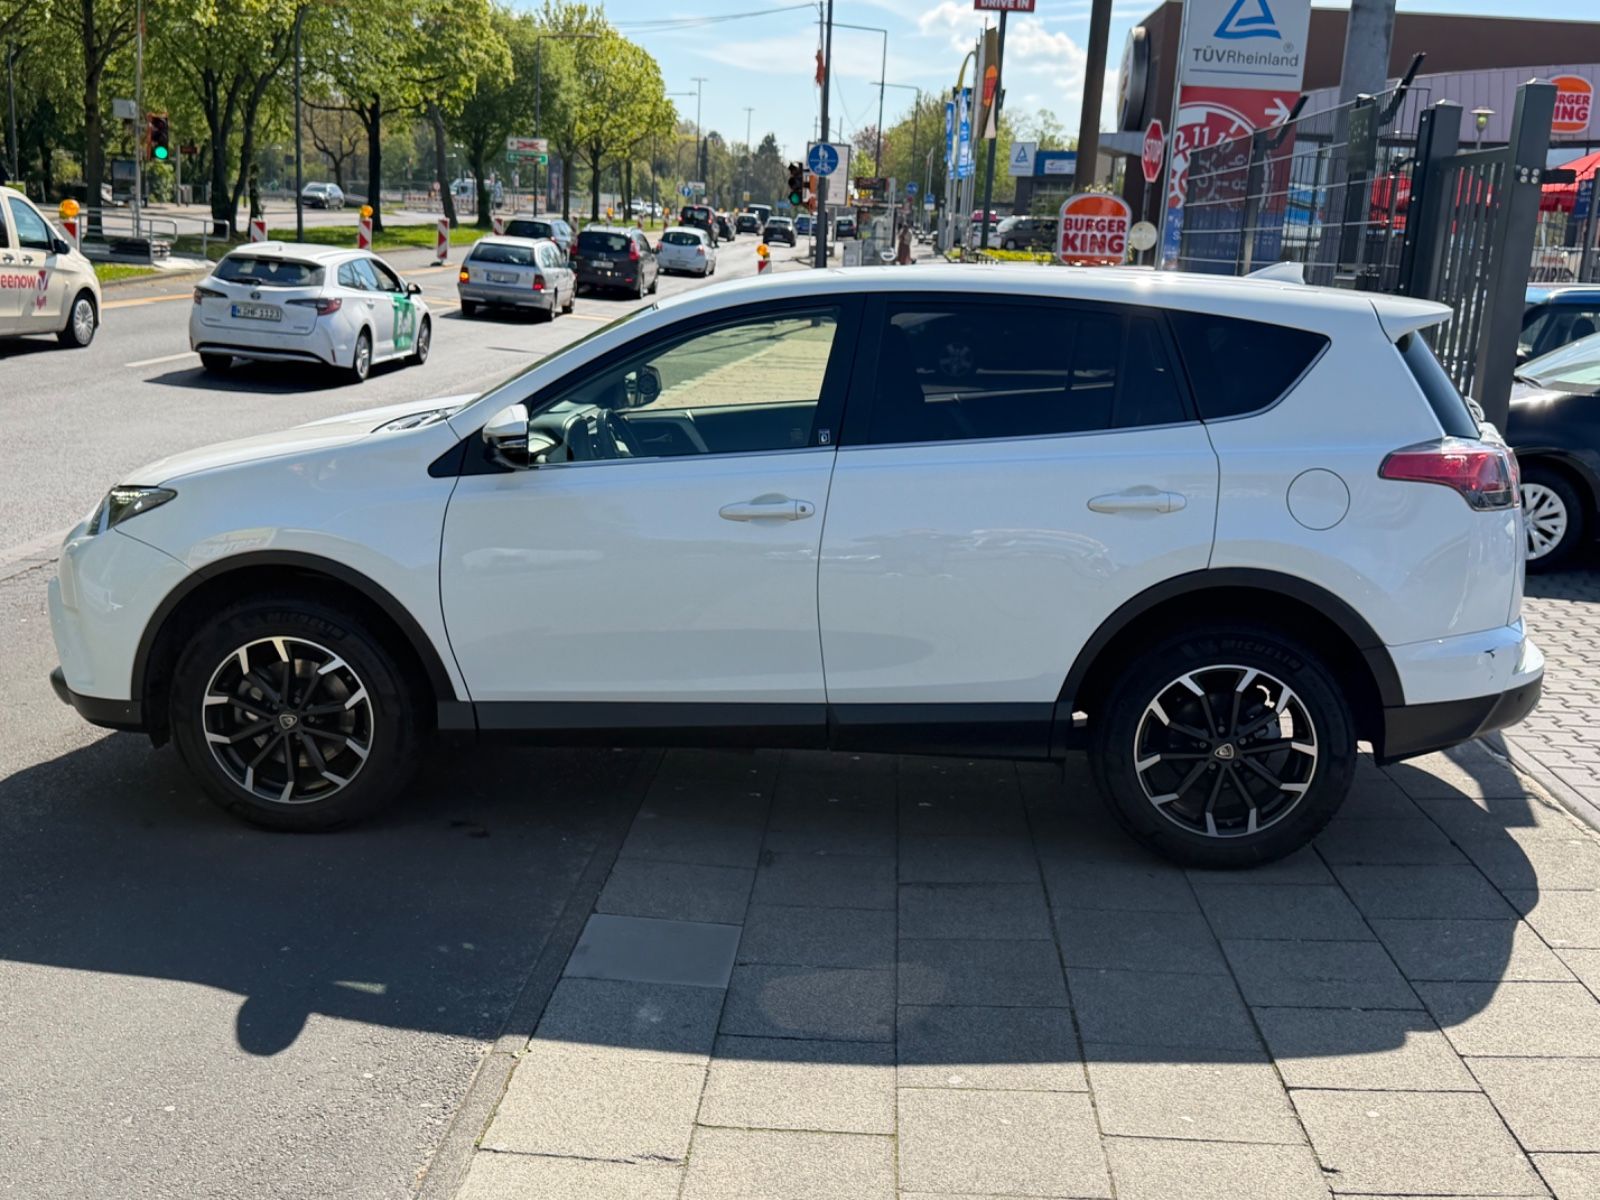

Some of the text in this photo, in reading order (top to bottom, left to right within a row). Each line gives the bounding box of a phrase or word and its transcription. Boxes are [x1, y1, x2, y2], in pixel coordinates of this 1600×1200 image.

[1192, 45, 1299, 67] TÜVRheinland
[1555, 94, 1590, 105] RGER
[1554, 105, 1589, 121] ING
[1144, 138, 1162, 164] STOP
[1063, 218, 1126, 233] BURGER
[1062, 233, 1125, 253] KING
